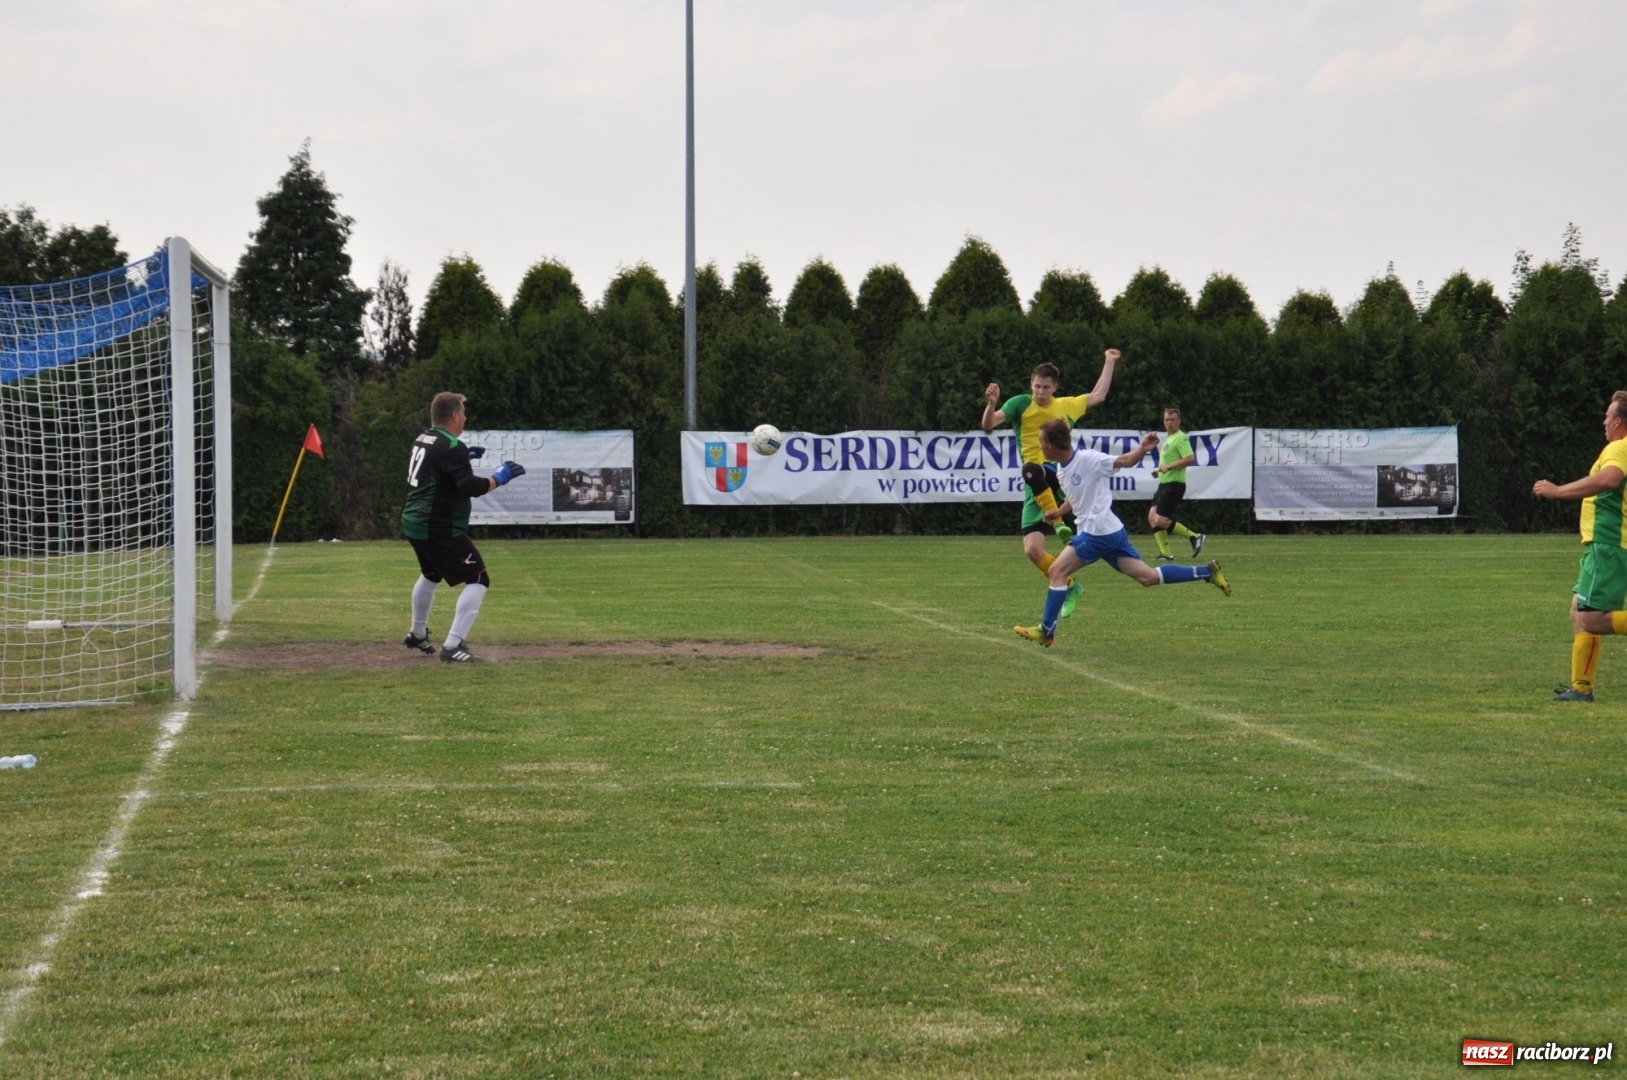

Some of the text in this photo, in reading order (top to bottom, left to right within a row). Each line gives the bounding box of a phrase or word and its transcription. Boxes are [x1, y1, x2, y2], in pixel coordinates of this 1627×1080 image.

[462, 432, 545, 450] EKTRO
[1259, 431, 1370, 448] ELEKTRO
[784, 436, 1021, 472] SERDECZNI
[1259, 449, 1342, 465] MARTI
[408, 445, 426, 487] 12
[878, 478, 897, 493] w
[902, 474, 1000, 498] powiecie
